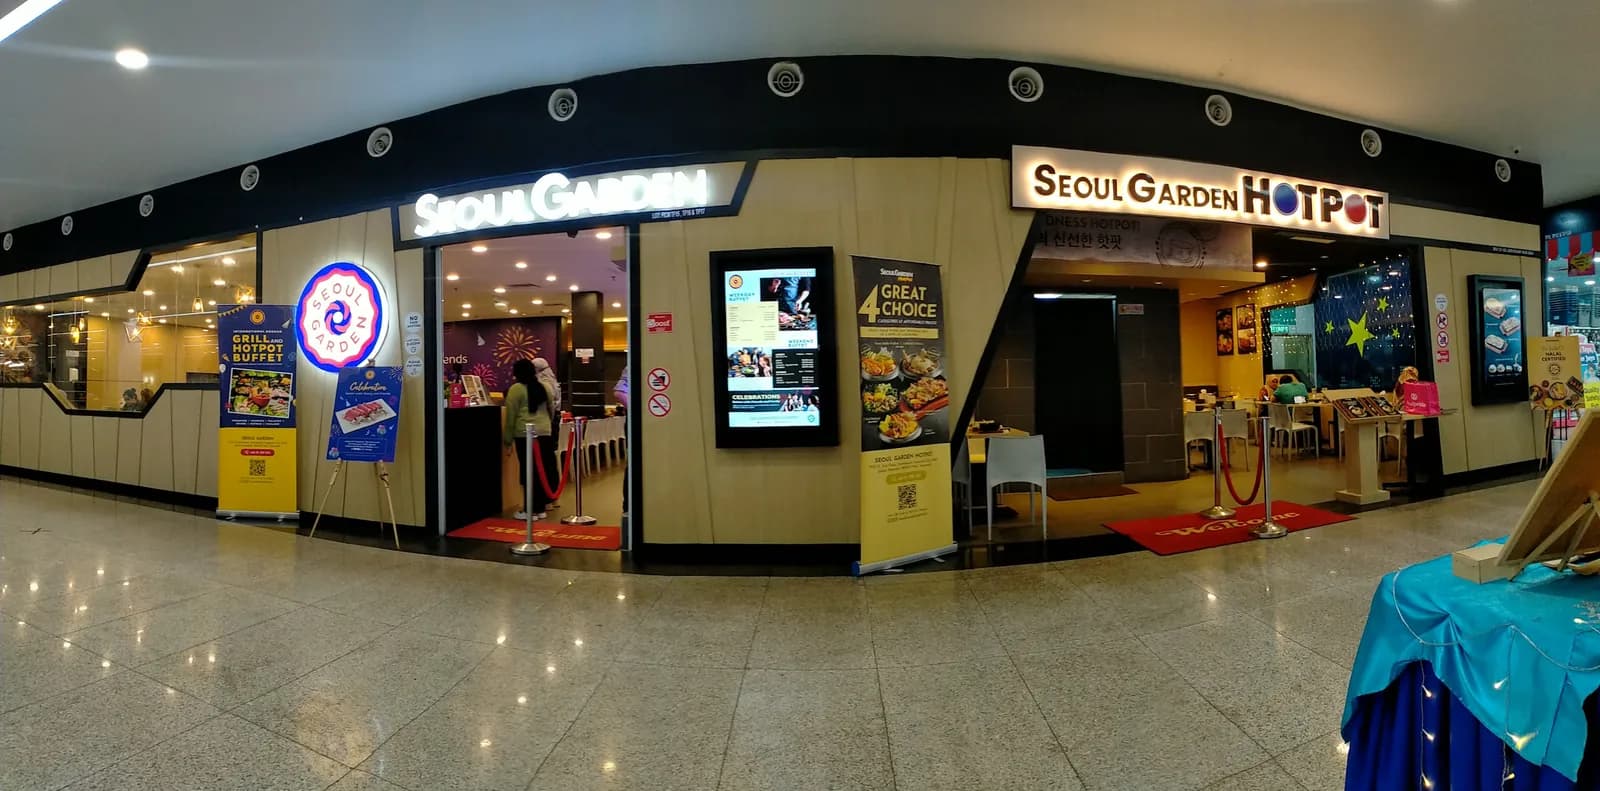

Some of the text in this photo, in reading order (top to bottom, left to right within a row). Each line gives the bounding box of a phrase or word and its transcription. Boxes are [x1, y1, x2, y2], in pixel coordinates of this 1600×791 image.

[1034, 163, 1384, 229] SEOUL GARDEN HOTPOT
[312, 282, 363, 310] SEOUL
[881, 284, 927, 300] GREAT
[857, 284, 880, 323] 4
[882, 301, 937, 318] CHOICE
[232, 334, 269, 343] GRILL
[311, 316, 367, 353] GARDEN
[232, 344, 284, 353] HOTPOT
[232, 353, 284, 362] BUFFET
